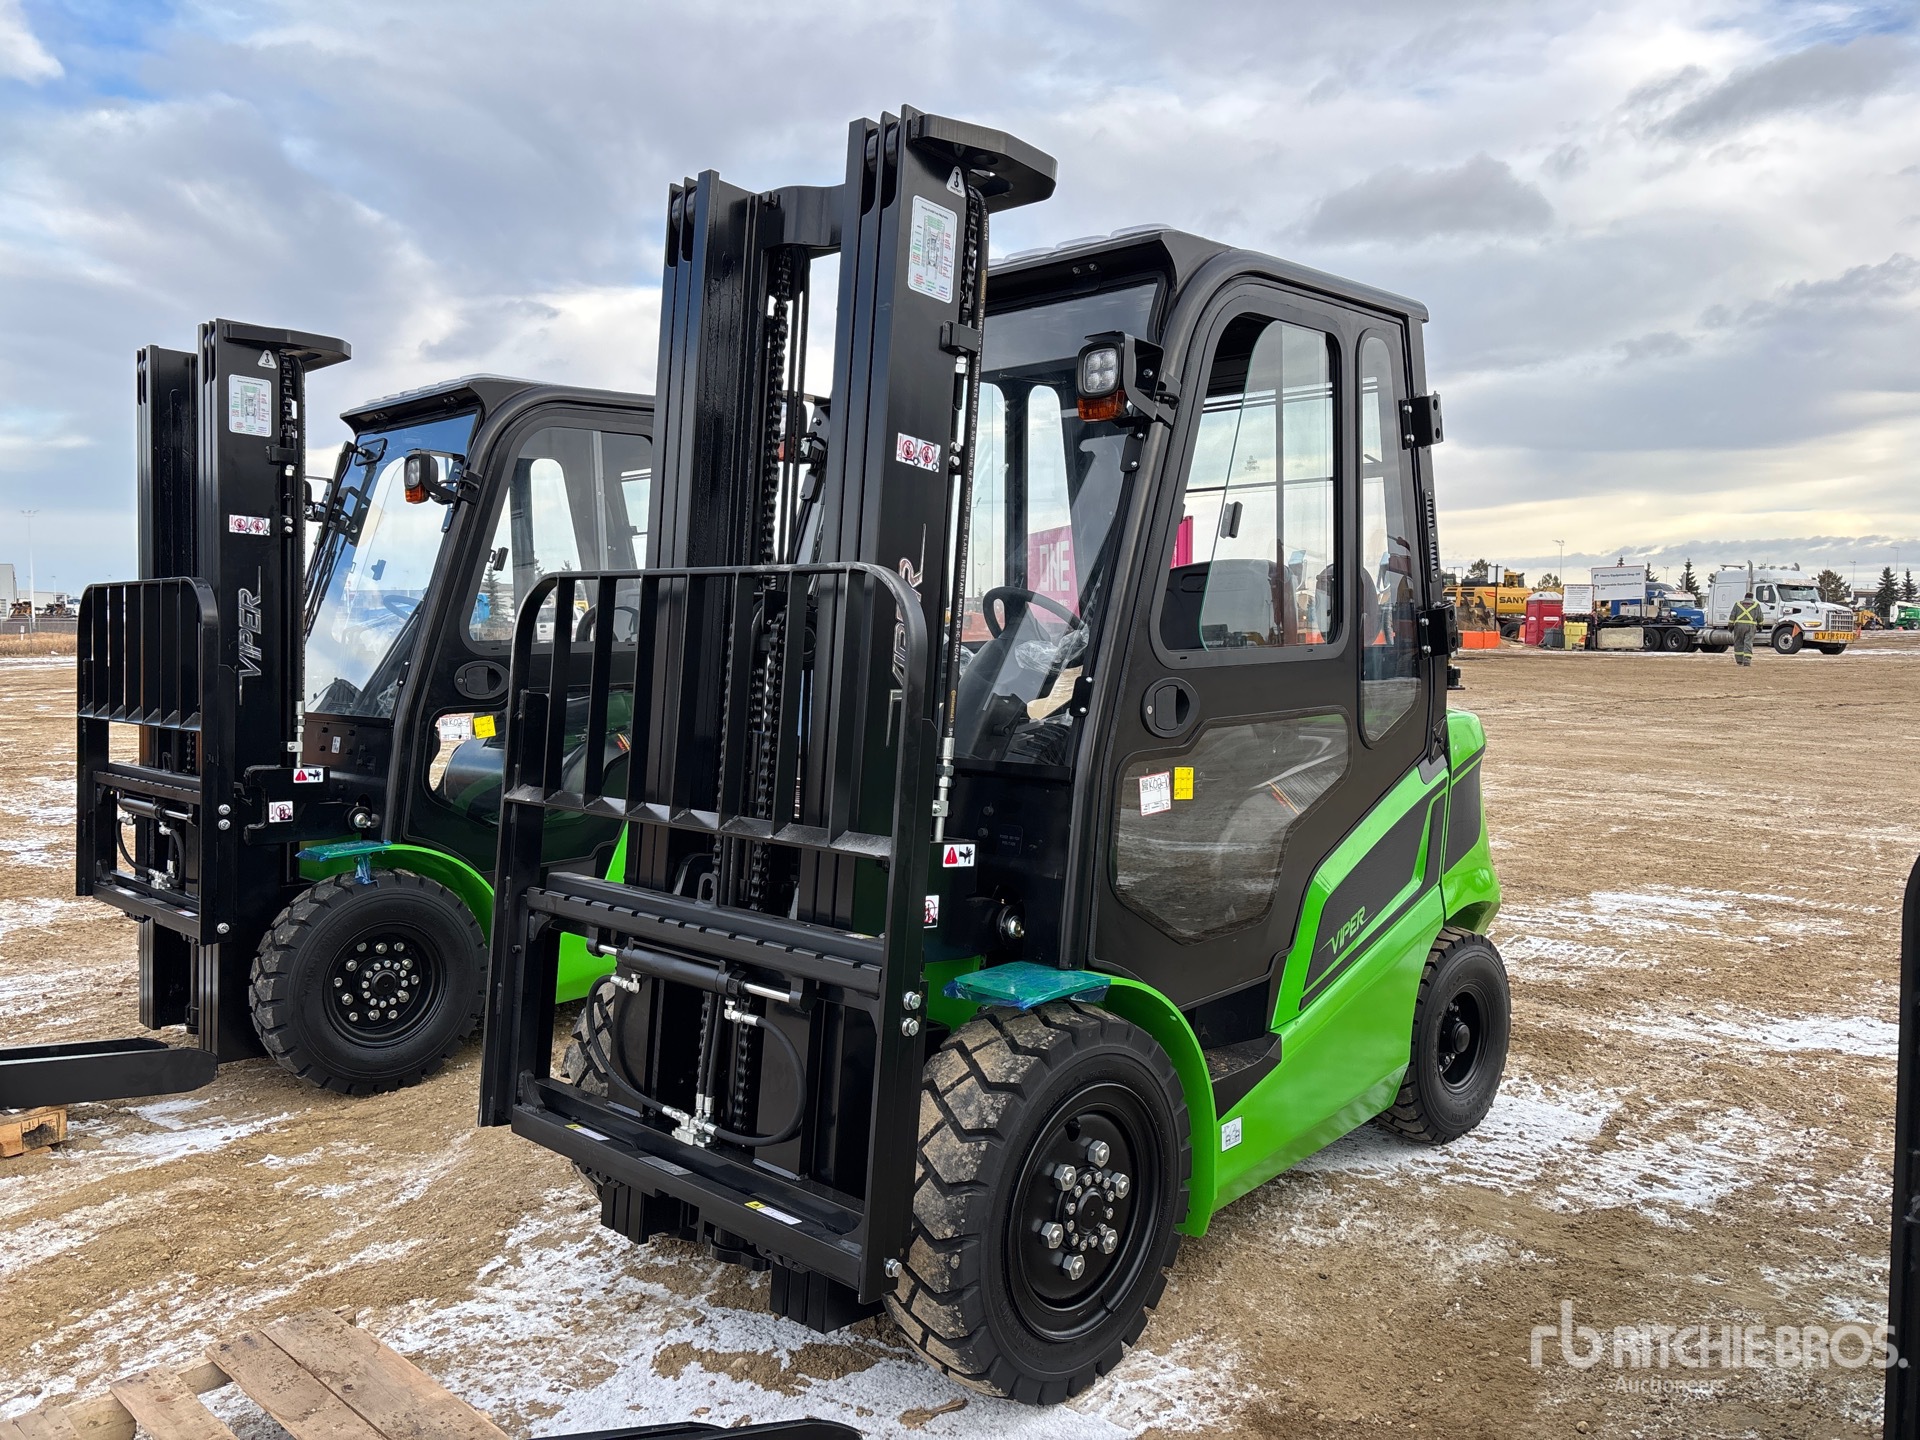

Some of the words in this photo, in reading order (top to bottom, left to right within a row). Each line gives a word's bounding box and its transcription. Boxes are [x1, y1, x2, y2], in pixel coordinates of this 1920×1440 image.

[958, 559, 966, 596] RESISTANT
[1039, 540, 1070, 592] ONE
[1499, 596, 1526, 604] SANY
[238, 587, 262, 676] VIPER
[1331, 905, 1366, 955] VIPER
